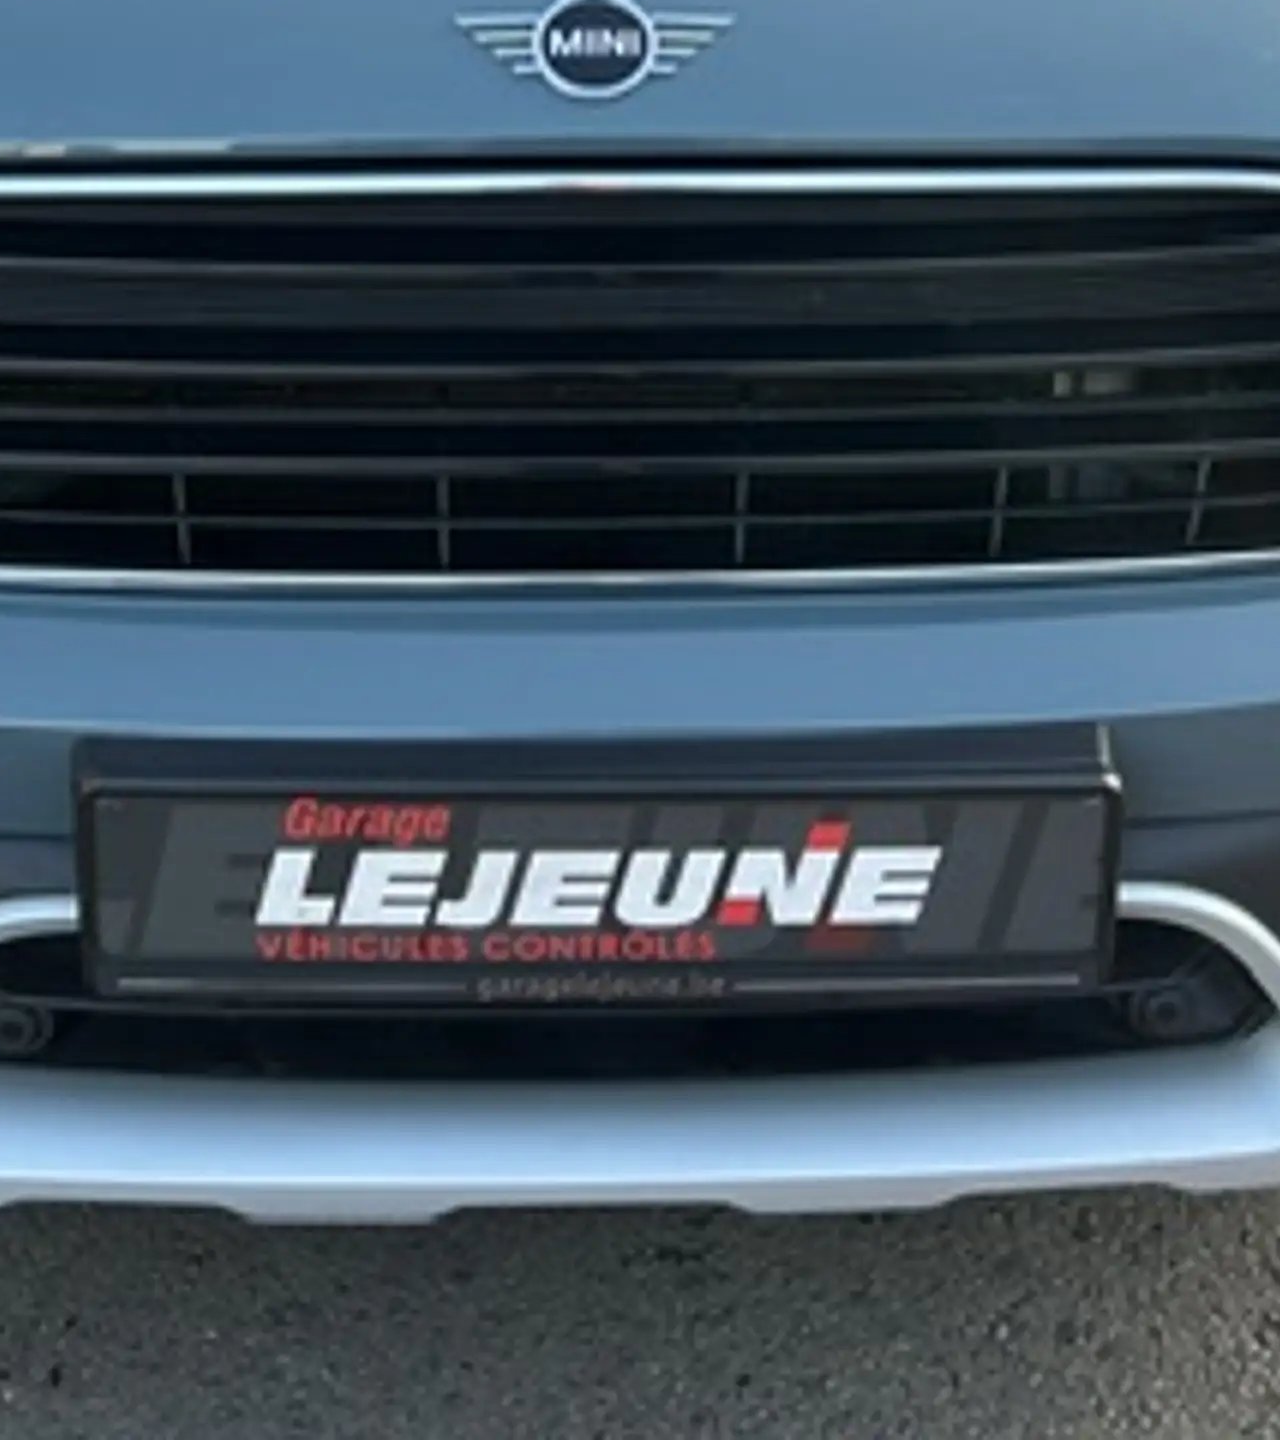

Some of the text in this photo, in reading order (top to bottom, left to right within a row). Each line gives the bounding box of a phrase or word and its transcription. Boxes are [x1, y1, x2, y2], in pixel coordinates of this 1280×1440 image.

[551, 27, 641, 58] MINI
[284, 797, 452, 845] Garage
[254, 818, 943, 927] LEJEUNE
[255, 927, 469, 961] VÉHICULES
